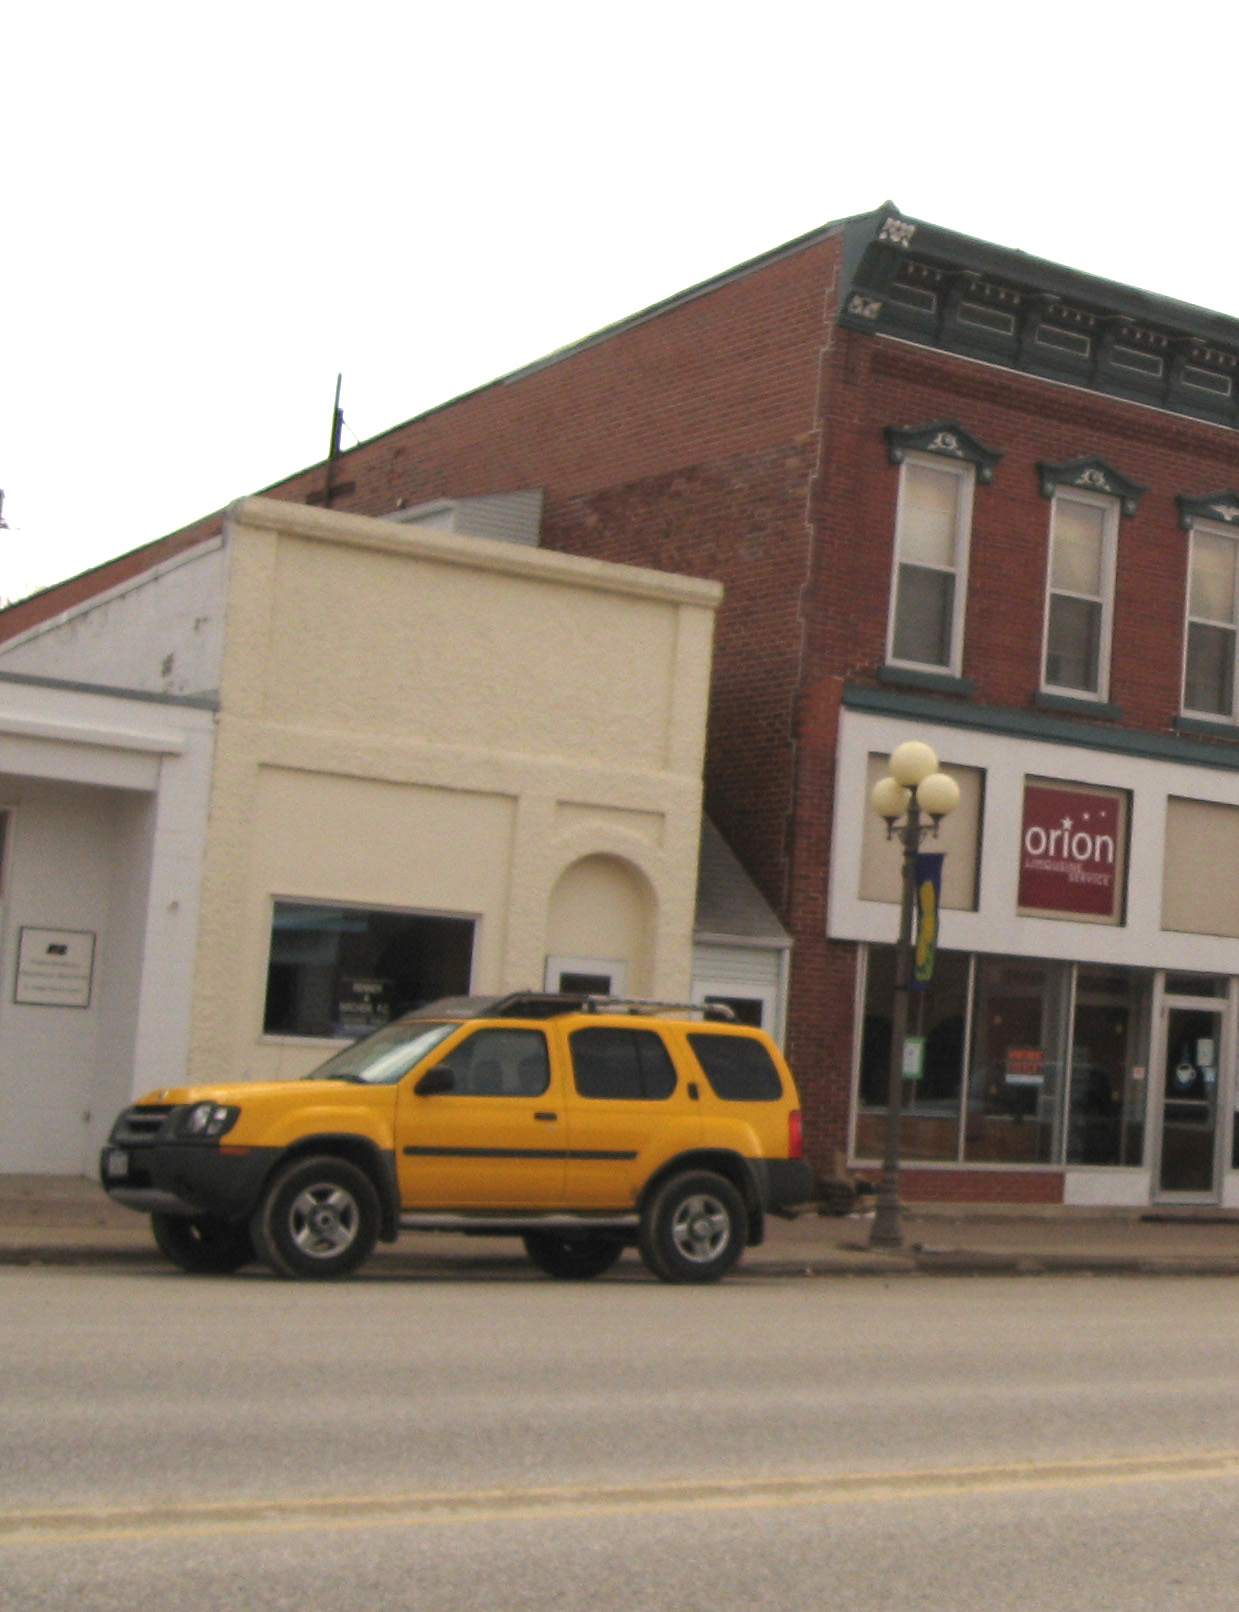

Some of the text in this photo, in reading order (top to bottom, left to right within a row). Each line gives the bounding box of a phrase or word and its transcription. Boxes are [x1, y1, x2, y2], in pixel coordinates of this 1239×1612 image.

[1024, 817, 1115, 863] orion
[1025, 859, 1083, 873] LIMOUSINE
[1069, 872, 1110, 886] SERVICE
